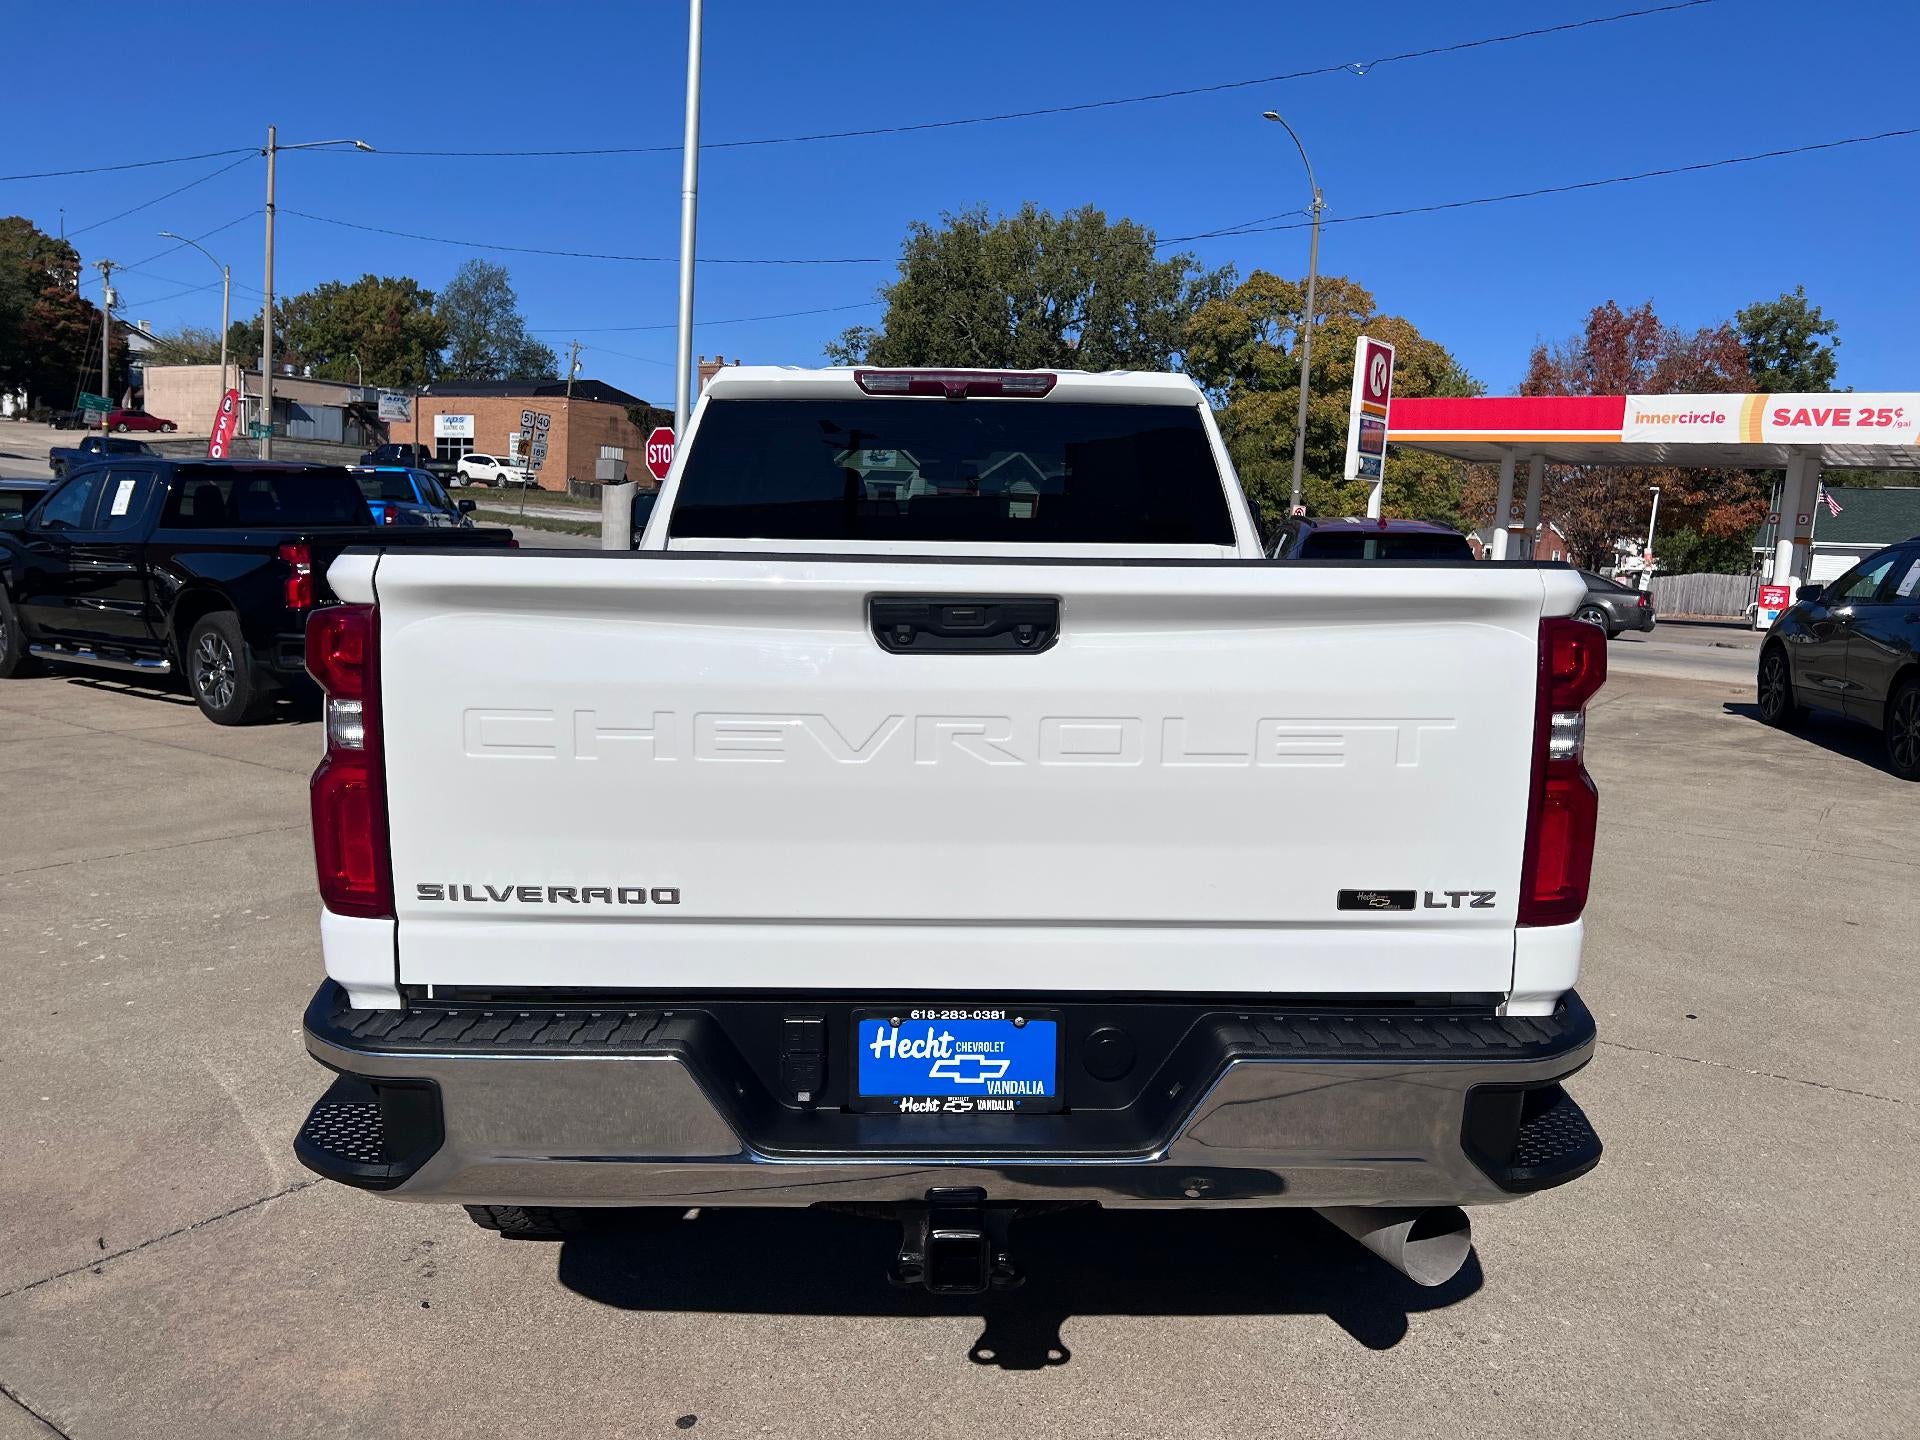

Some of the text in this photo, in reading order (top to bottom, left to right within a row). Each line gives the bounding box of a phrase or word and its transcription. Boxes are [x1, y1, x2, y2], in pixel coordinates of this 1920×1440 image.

[1373, 361, 1385, 393] K
[523, 413, 533, 424] 51
[537, 417, 549, 427] 40
[1634, 410, 1726, 425] innercircle
[1772, 408, 1851, 427] SAVE
[533, 448, 545, 458] 185
[462, 708, 1457, 770] CHEVROLET
[416, 883, 681, 905] SILVERADO
[1424, 890, 1497, 908] LTZ
[910, 1009, 1006, 1020] 618-283-0381
[870, 1026, 1005, 1059] Hecht CHEVROLET
[986, 1080, 1045, 1095] VANDALIA
[899, 1097, 941, 1113] Hecht
[976, 1099, 1015, 1111] VANDALIA
